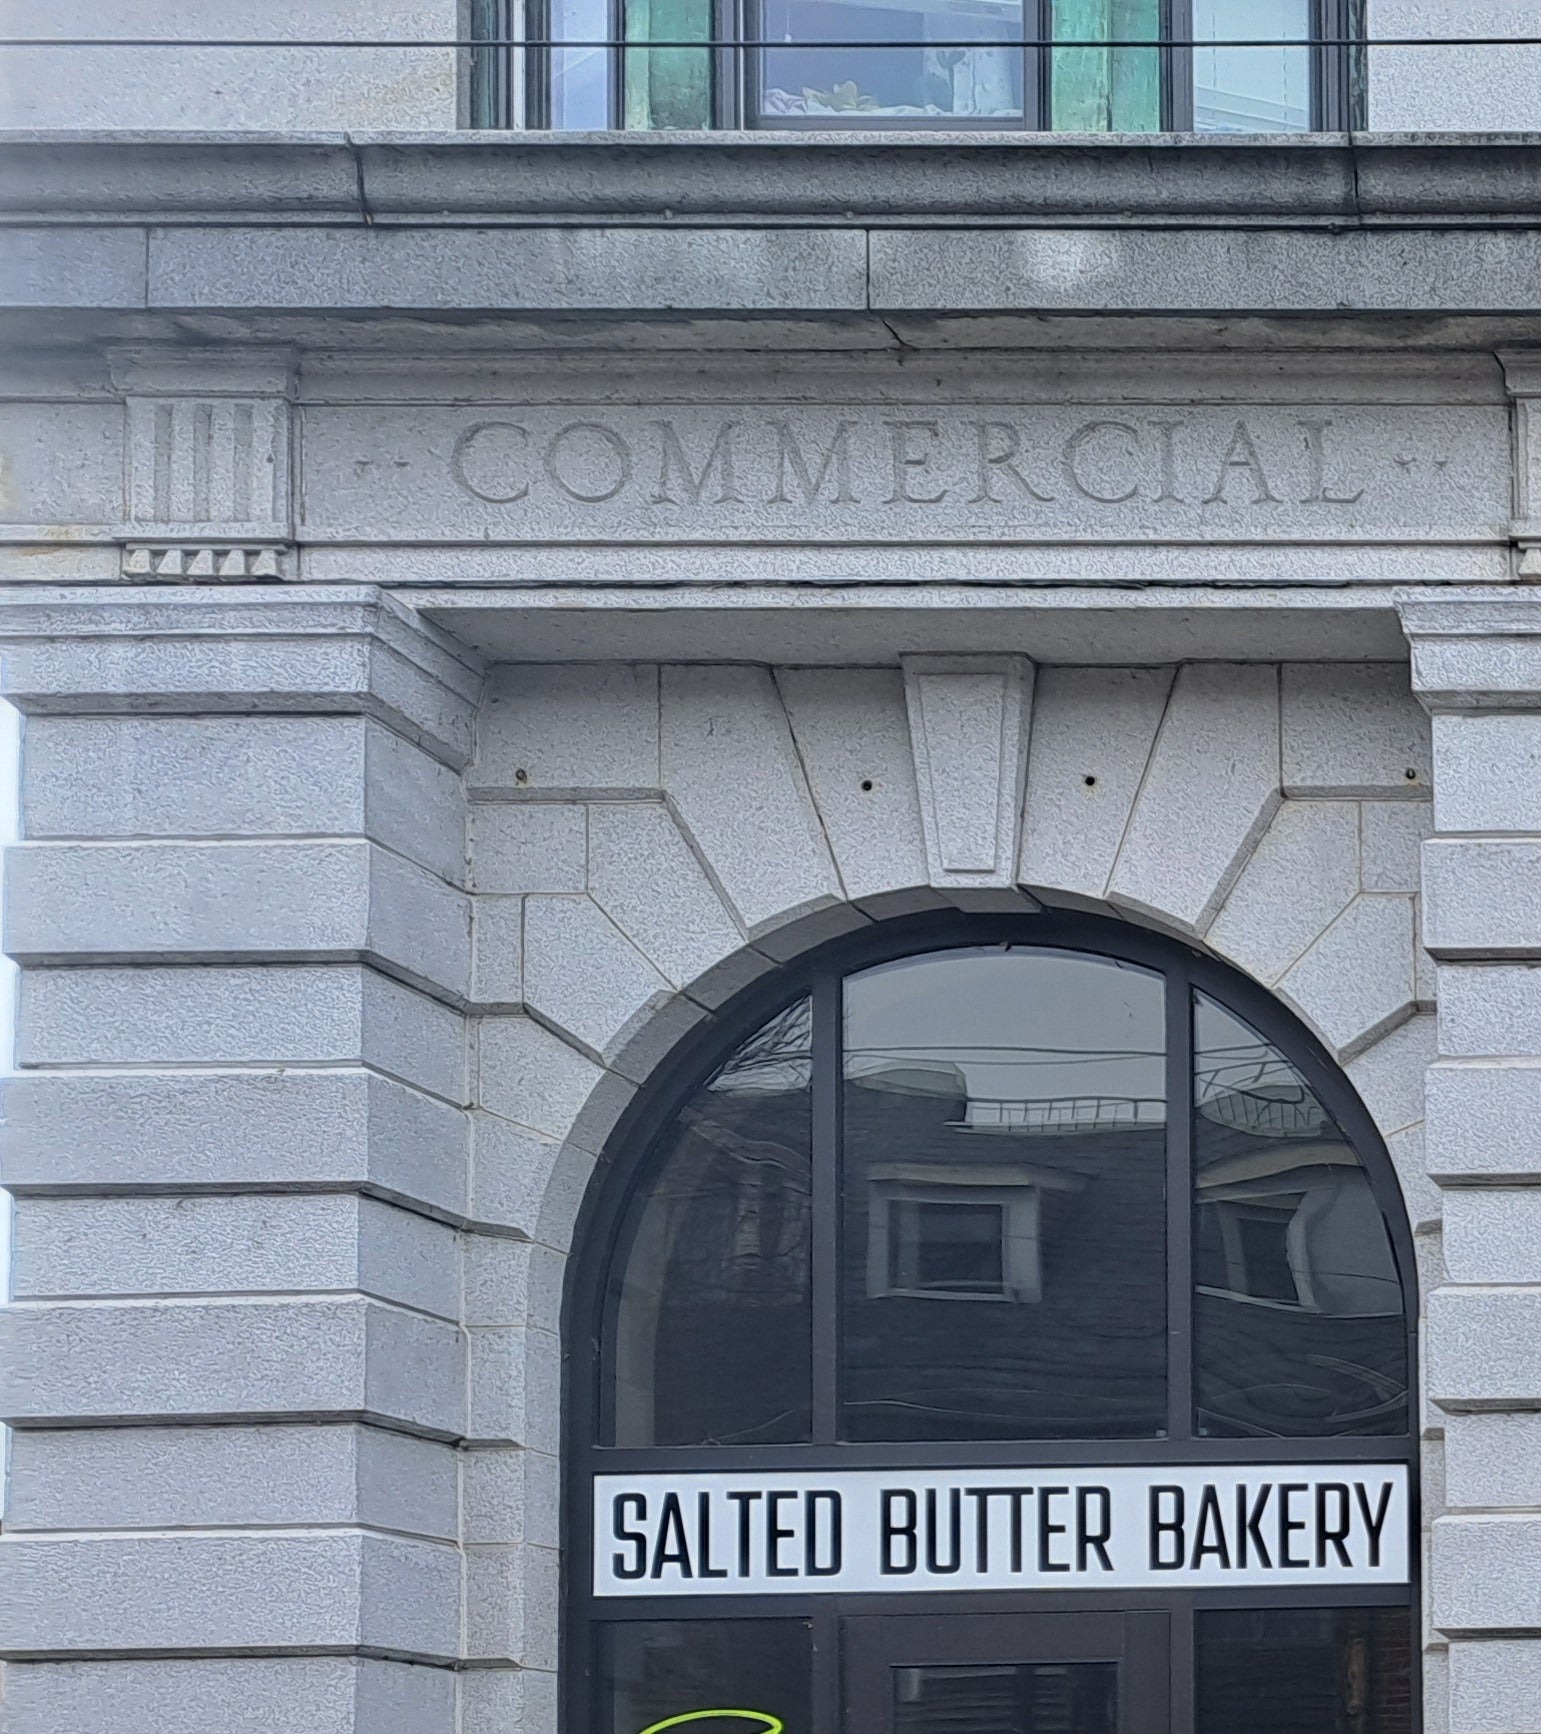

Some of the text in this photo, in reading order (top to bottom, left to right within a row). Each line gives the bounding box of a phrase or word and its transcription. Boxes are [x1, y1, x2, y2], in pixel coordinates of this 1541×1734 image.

[447, 418, 1367, 506] COMMERCIAL
[612, 1481, 1394, 1580] SALTED BUTTER BAKERY
